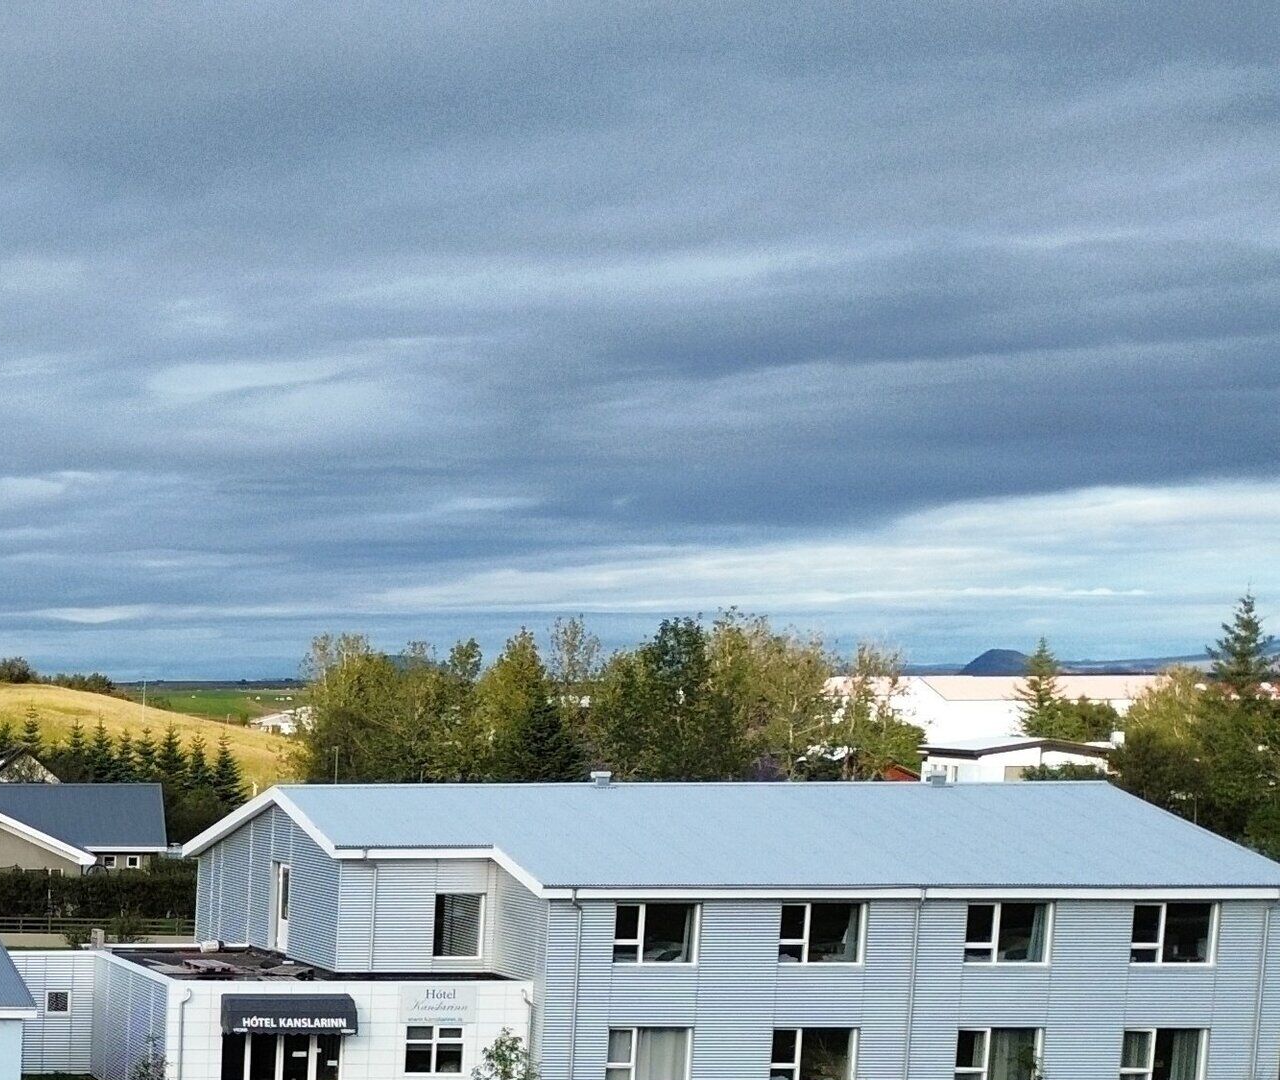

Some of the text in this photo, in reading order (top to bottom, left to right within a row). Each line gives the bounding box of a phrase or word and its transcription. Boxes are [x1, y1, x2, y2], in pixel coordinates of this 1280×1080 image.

[426, 989, 456, 999] Hótel
[242, 1016, 347, 1028] HÓTEL KANSLARINN
